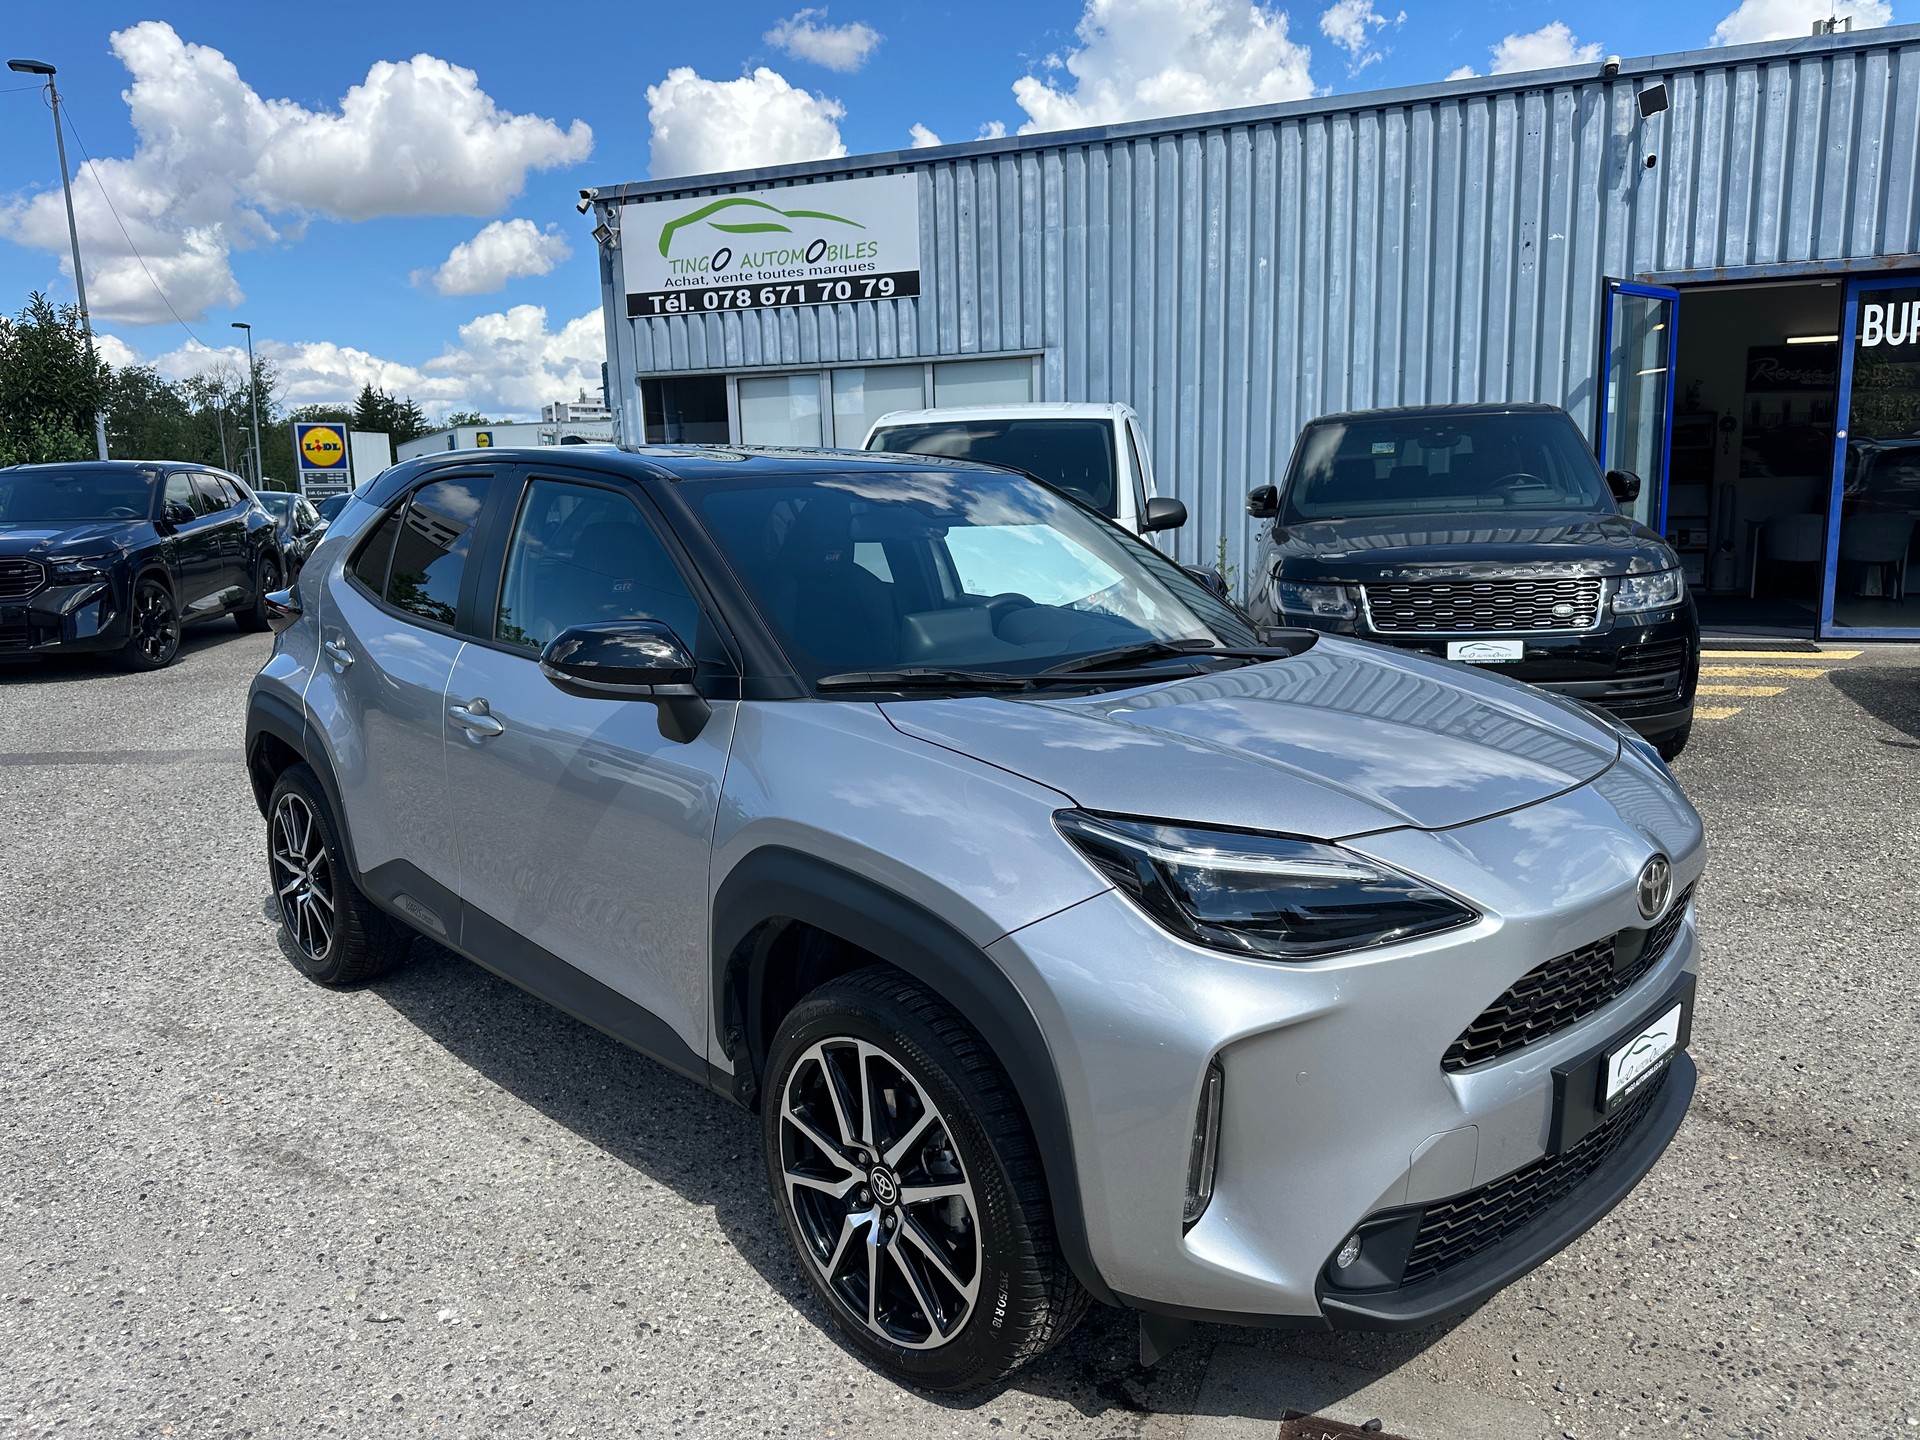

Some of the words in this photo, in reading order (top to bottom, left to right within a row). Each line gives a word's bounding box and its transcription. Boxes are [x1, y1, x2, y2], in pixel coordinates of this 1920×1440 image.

[669, 247, 732, 274] TINGO
[740, 238, 878, 269] AUTOMOBILES
[664, 275, 709, 288] Achat,
[713, 272, 753, 283] vente
[758, 268, 804, 280] toutes
[809, 262, 876, 275] marques
[648, 293, 695, 313] Tél.
[703, 289, 752, 309] 078
[760, 284, 805, 306] 671
[817, 281, 852, 300] 70
[860, 277, 895, 297] 79
[1380, 568, 1472, 578] RANGE
[1492, 564, 1584, 576] ROVER
